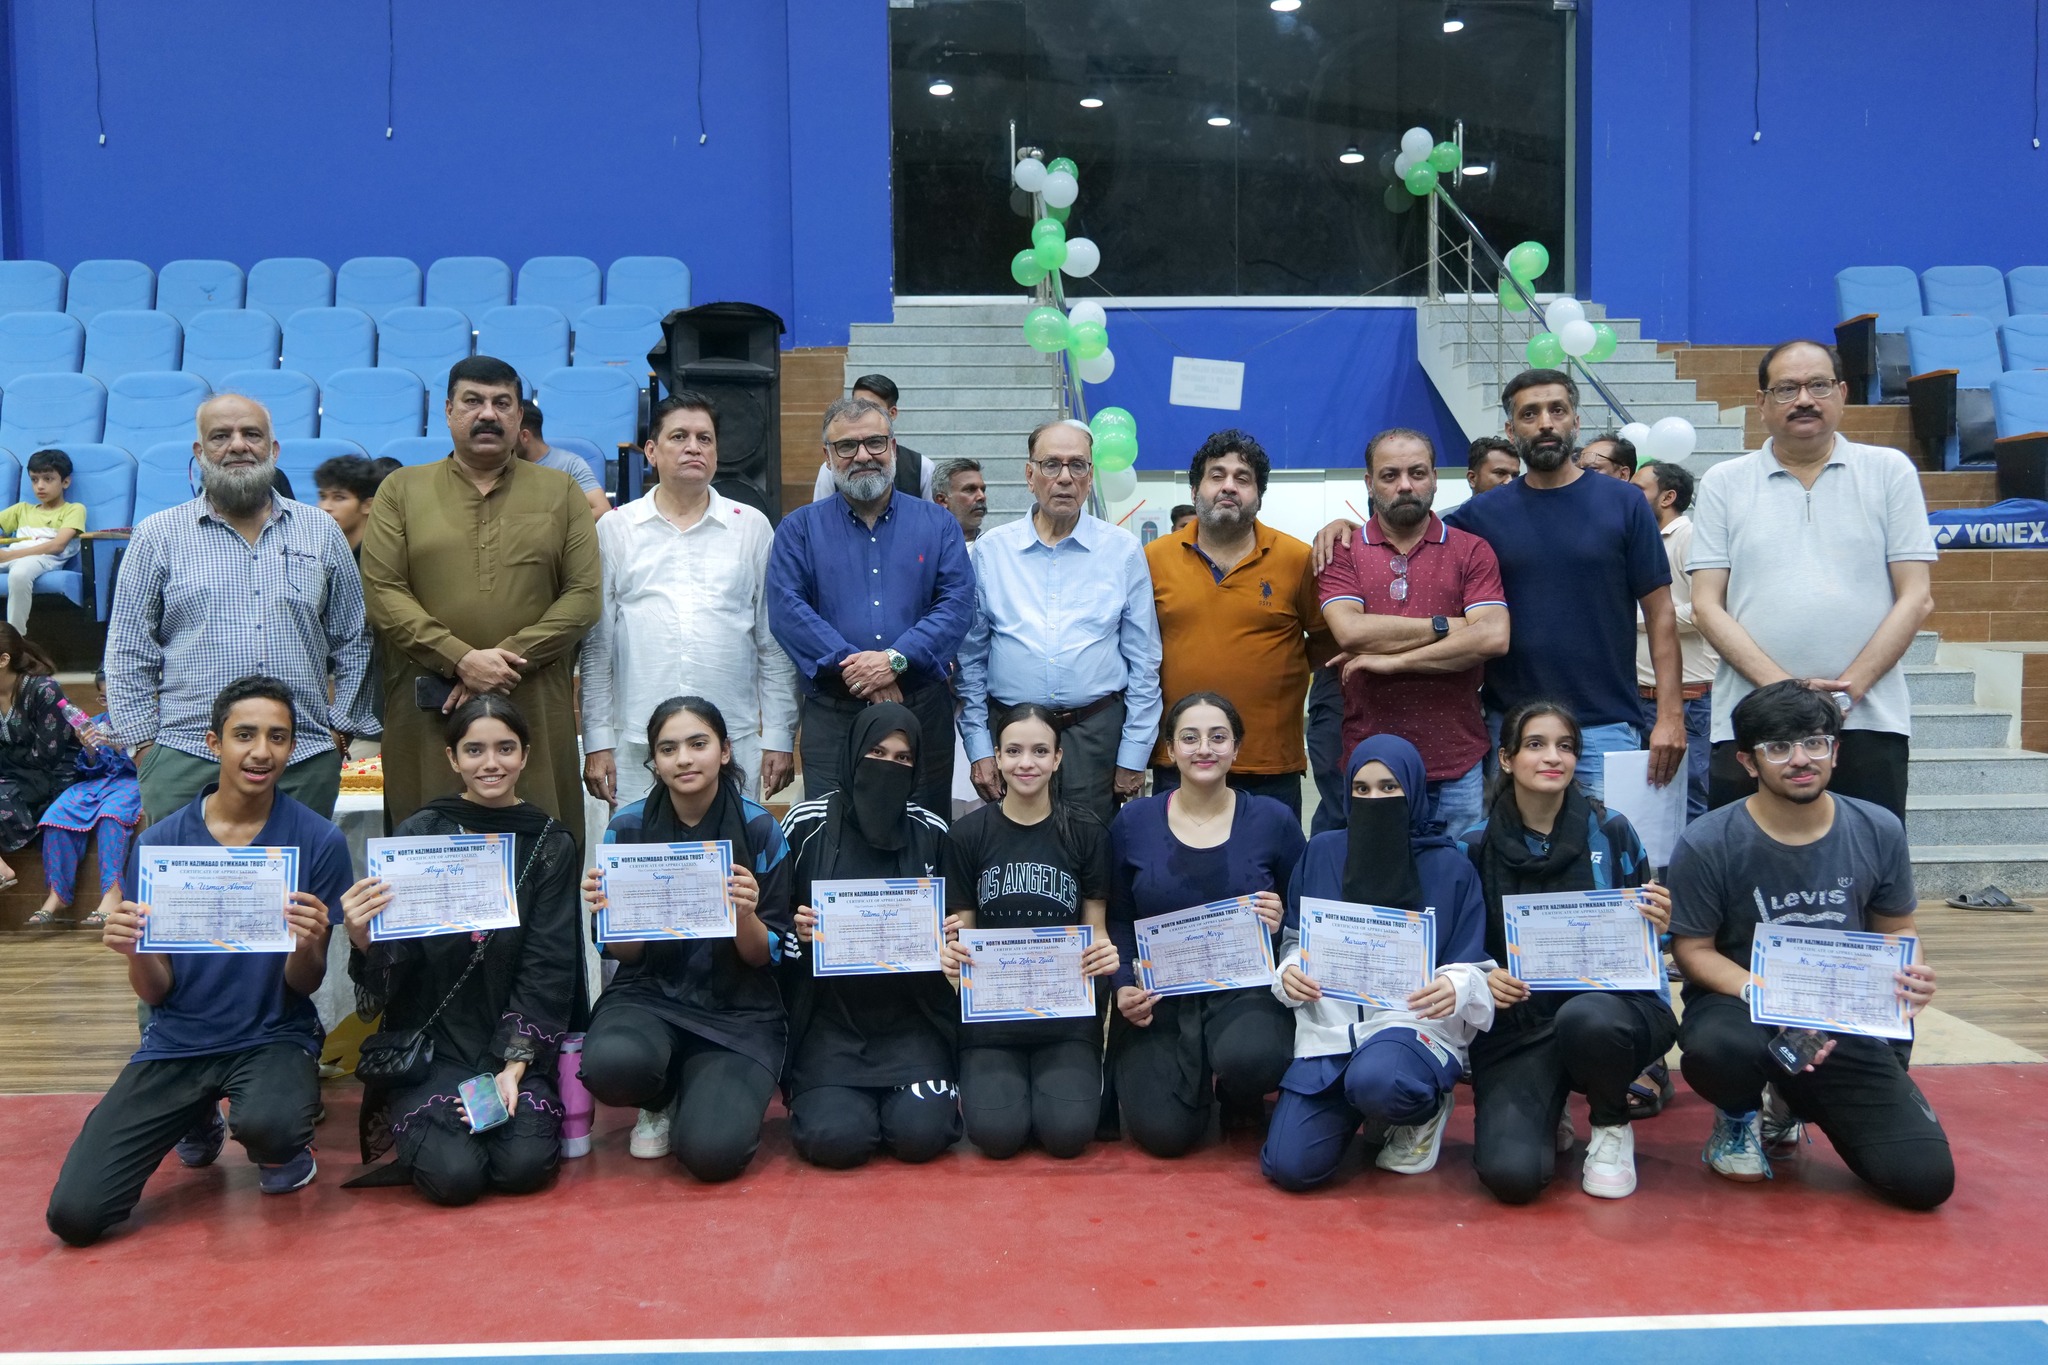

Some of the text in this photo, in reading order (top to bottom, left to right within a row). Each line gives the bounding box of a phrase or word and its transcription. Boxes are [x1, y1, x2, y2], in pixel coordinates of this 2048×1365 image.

[1965, 521, 2045, 544] YONEX
[1002, 863, 1077, 913] ANGELES
[1176, 916, 1201, 925] NAZIMABAD
[1340, 915, 1366, 923] NAZIMABAD
[1366, 918, 1391, 927] GYMKHANA
[1804, 938, 1834, 947] NAZIMABAD
[1835, 941, 1864, 949] GYMKHANA
